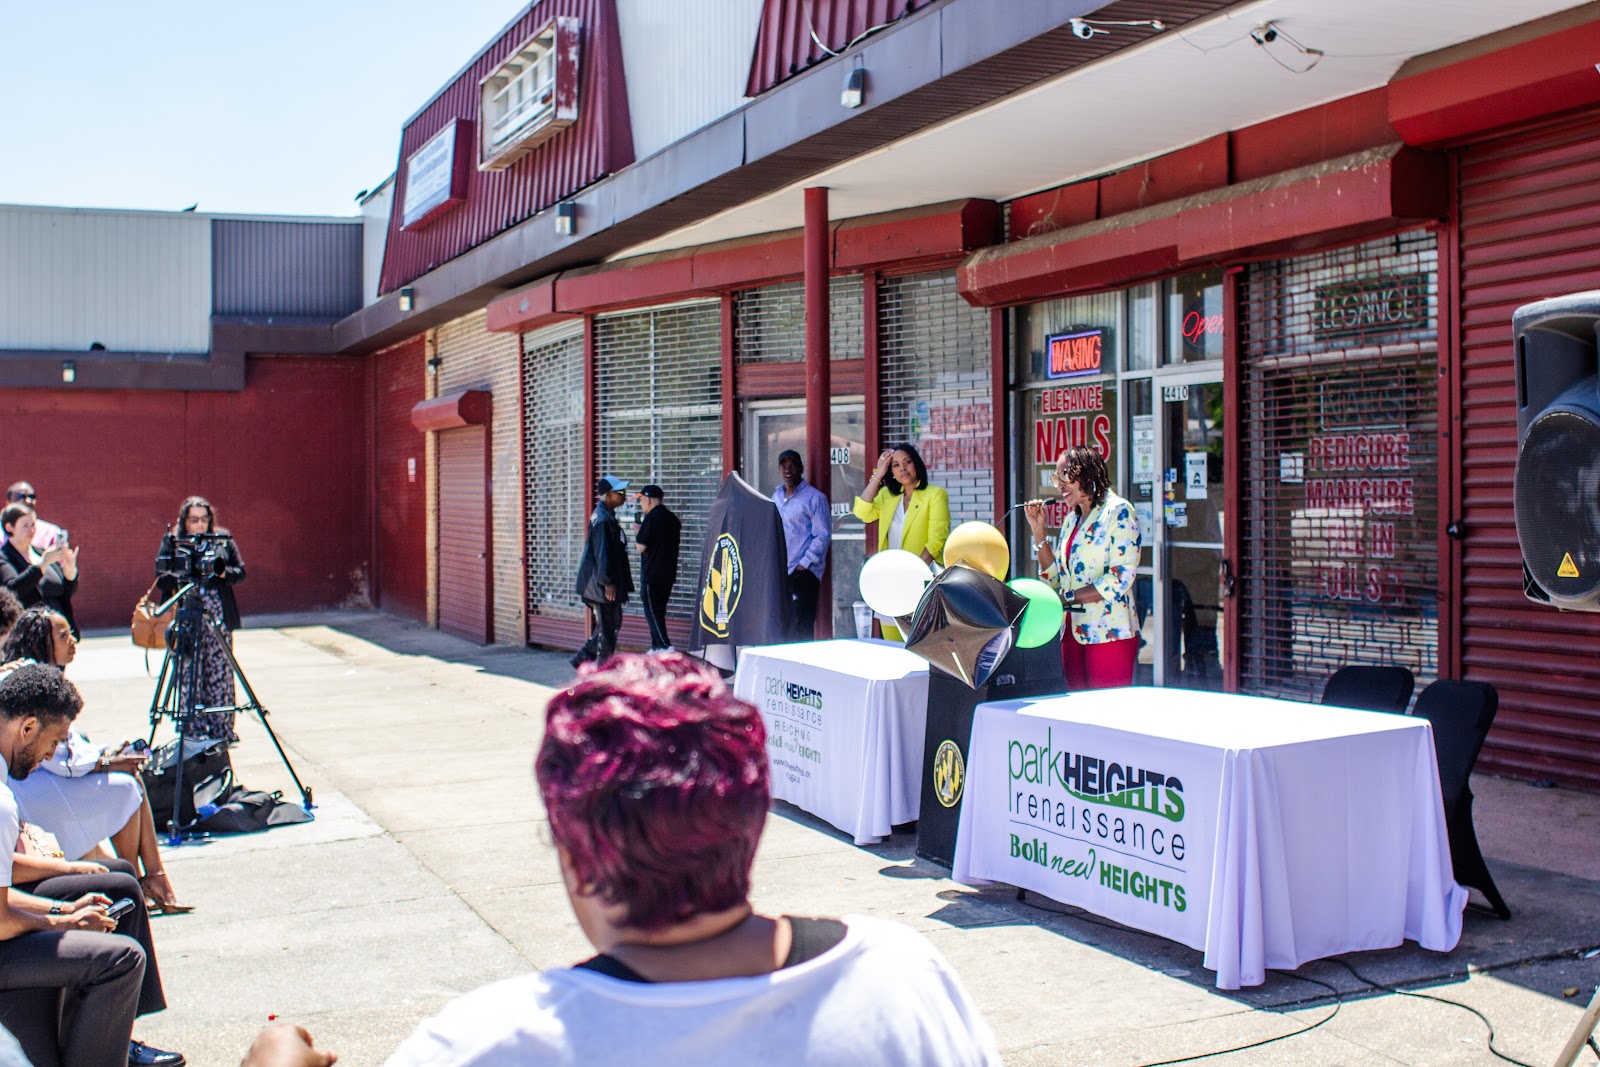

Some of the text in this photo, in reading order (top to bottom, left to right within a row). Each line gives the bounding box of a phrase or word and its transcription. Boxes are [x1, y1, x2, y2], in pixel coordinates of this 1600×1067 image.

[1182, 311, 1224, 344] Open
[1051, 335, 1102, 373] WAXING
[1042, 385, 1103, 414] ELEGANCE
[1165, 385, 1188, 400] 4410
[922, 439, 994, 470] OPENIN
[1035, 414, 1111, 465] NAILS
[1309, 433, 1411, 471] PEDICURE
[831, 503, 849, 515] ULL
[1305, 478, 1414, 515] MANICURE
[1327, 521, 1395, 558] FILL IN
[1316, 563, 1362, 600] FULL
[765, 672, 822, 710] park HEIGHTS
[767, 698, 822, 726] renaissance
[1008, 726, 1185, 823] park HEIGHTS
[1016, 791, 1186, 862] renaissance
[1009, 833, 1187, 913] Bold new HEIGHTS
